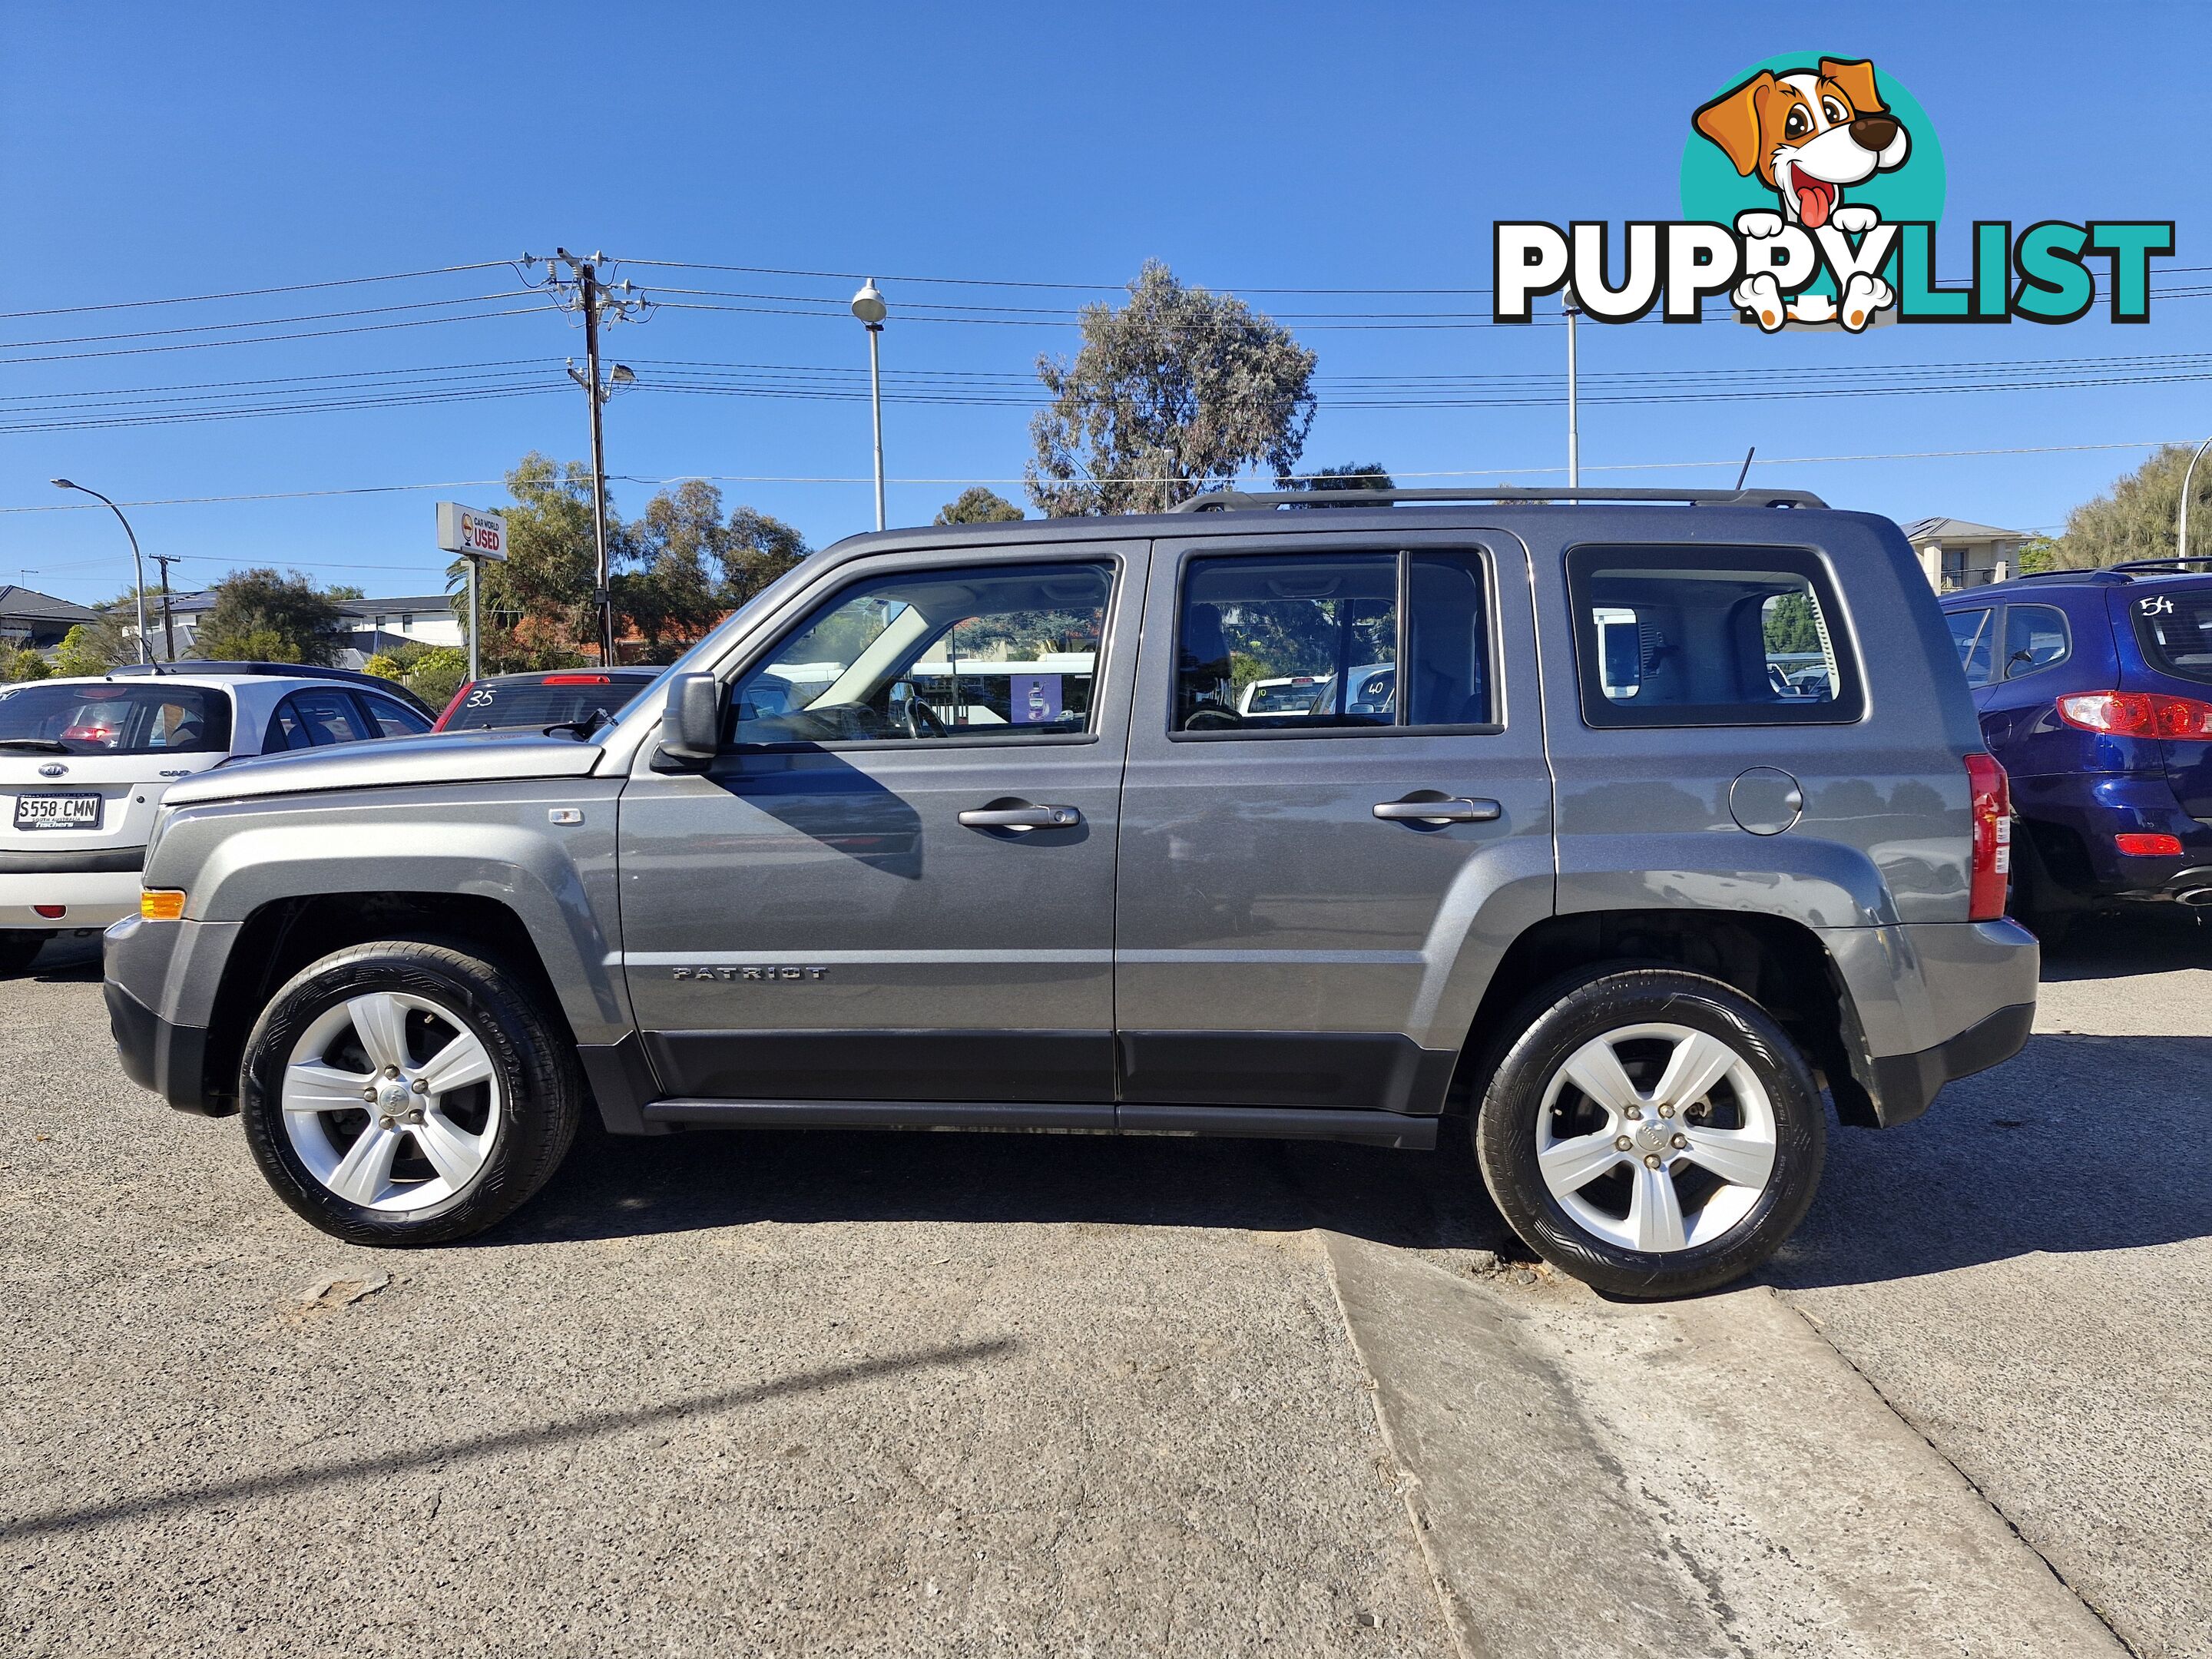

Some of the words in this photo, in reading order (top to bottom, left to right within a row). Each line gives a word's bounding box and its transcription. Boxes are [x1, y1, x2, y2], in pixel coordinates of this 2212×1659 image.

[474, 518, 483, 528] CAR
[484, 520, 499, 531] WORLD
[475, 528, 499, 551] USED
[2140, 596, 2174, 616] 54
[1369, 682, 1383, 694] 40
[467, 690, 497, 707] 35
[40, 764, 66, 776] KIA
[673, 967, 828, 980] PATRIOT
